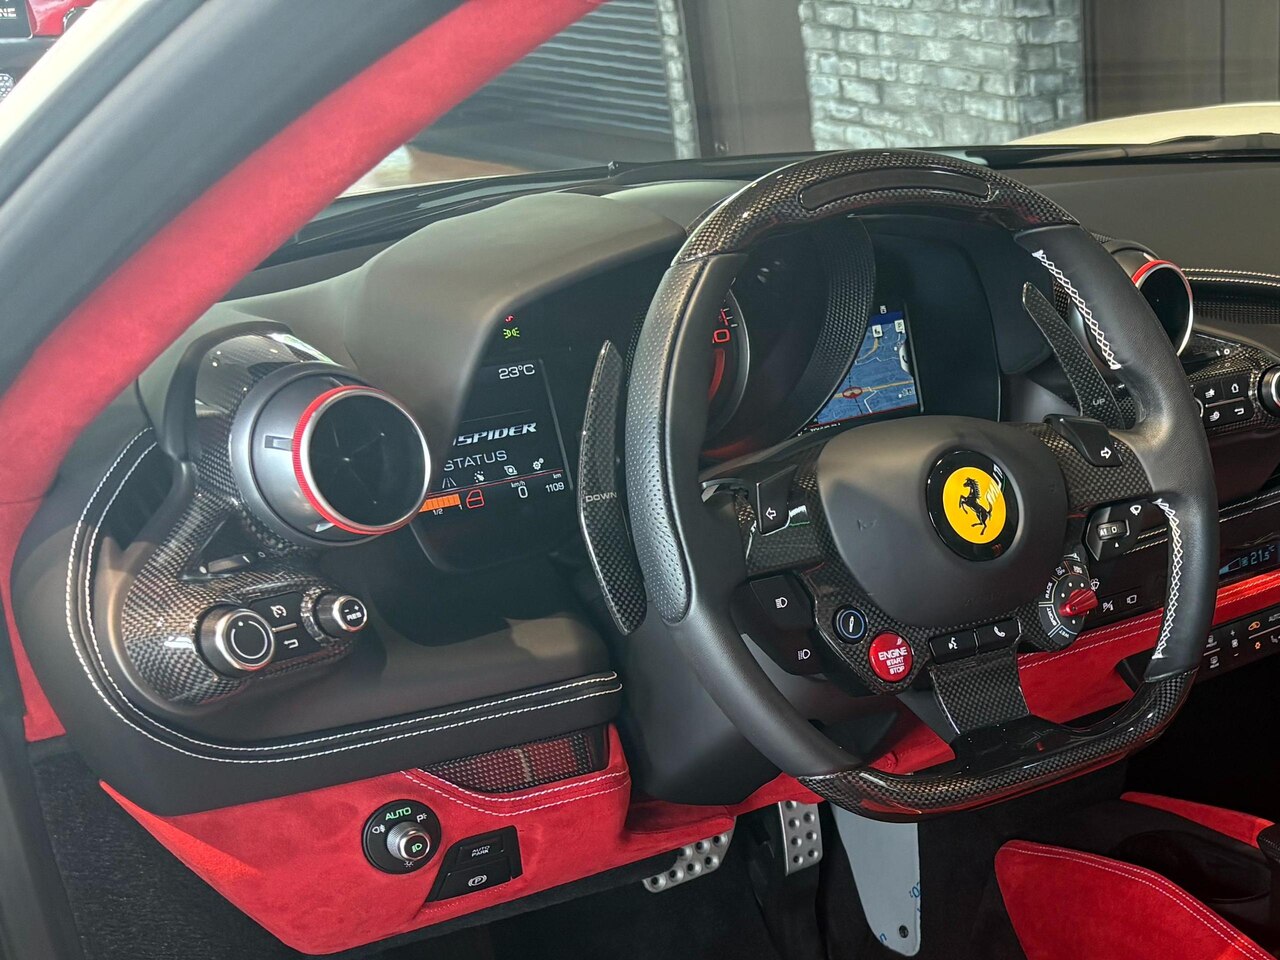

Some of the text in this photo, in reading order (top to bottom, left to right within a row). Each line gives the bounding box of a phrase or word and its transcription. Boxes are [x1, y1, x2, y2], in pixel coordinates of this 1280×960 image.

[457, 422, 537, 446] SPIDER
[444, 450, 508, 471] STATUS
[545, 482, 565, 492] 1109
[585, 492, 617, 503] DOWN
[1045, 582, 1053, 599] RACE
[1046, 607, 1058, 627] SPORT
[1059, 629, 1070, 639] WET
[878, 647, 907, 661] ENGINE
[886, 657, 904, 666] START
[889, 666, 905, 675] STOP
[385, 807, 411, 820] AUTO
[472, 845, 490, 853] AUTO
